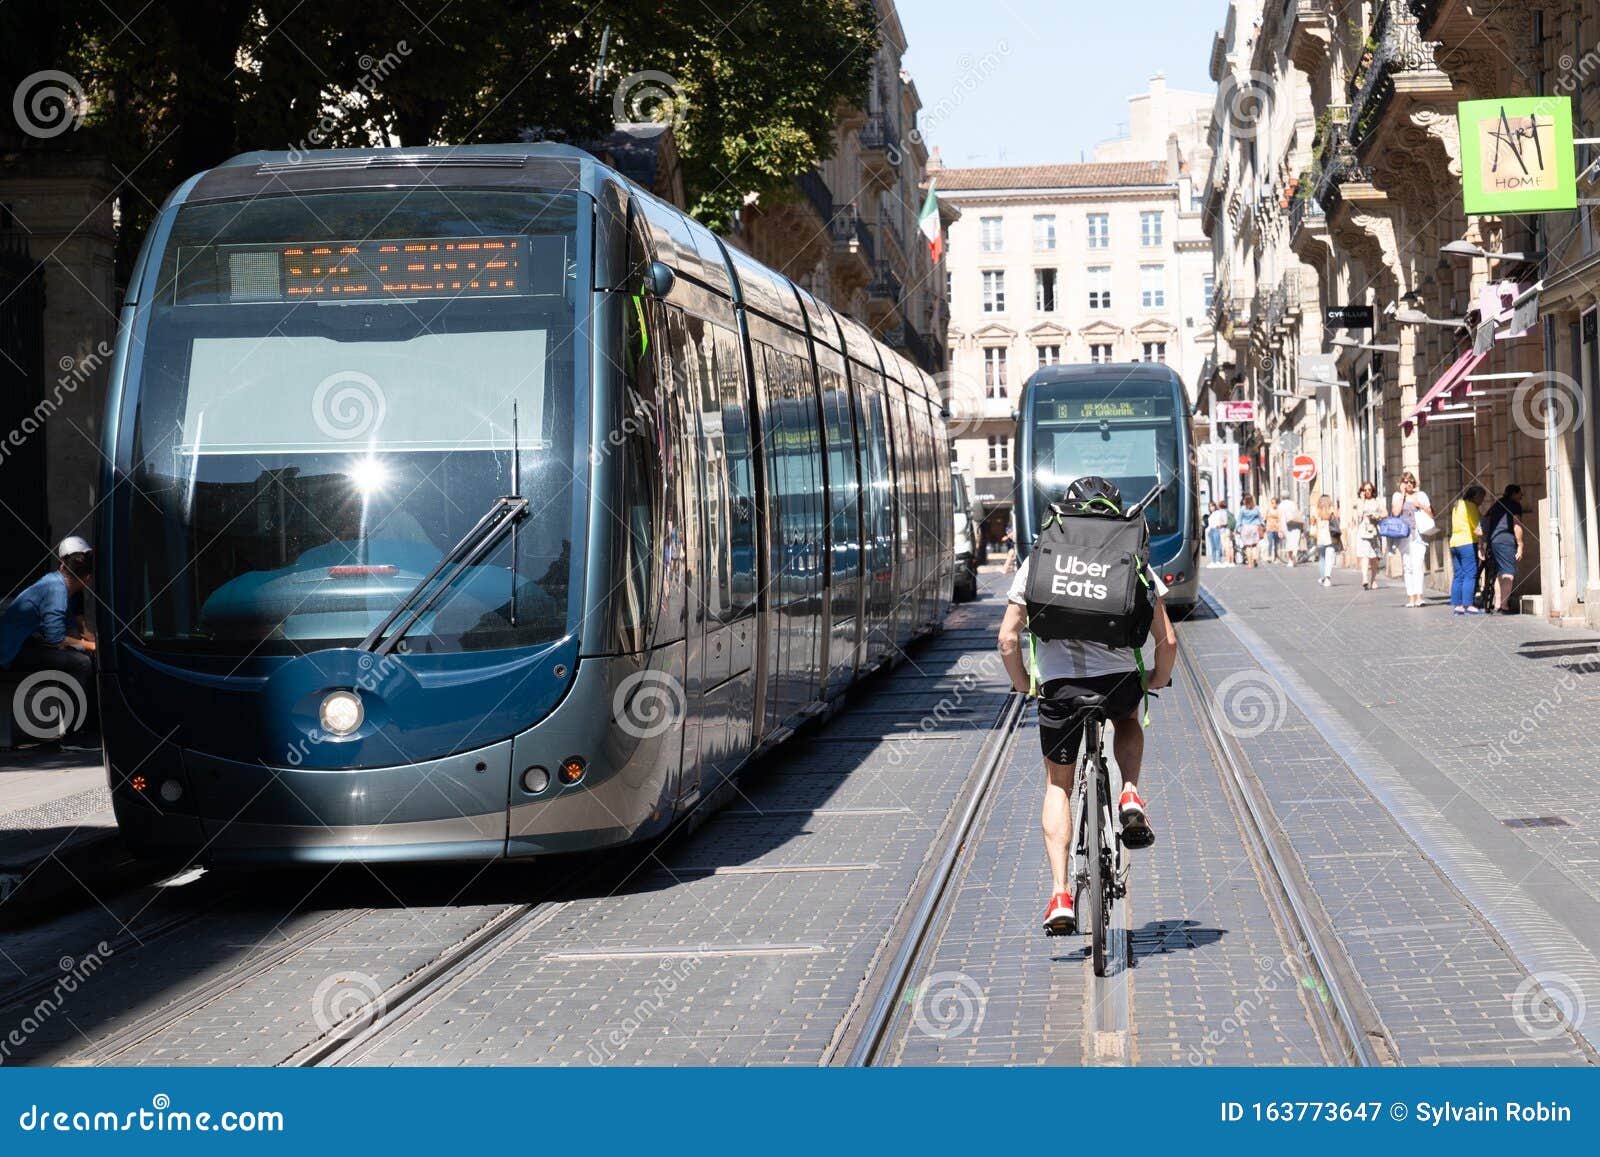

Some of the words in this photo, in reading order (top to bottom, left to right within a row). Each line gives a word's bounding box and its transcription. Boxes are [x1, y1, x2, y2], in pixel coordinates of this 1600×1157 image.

[1495, 177, 1544, 189] HOME
[1055, 554, 1111, 578] Uber
[1051, 574, 1108, 600] Eats
